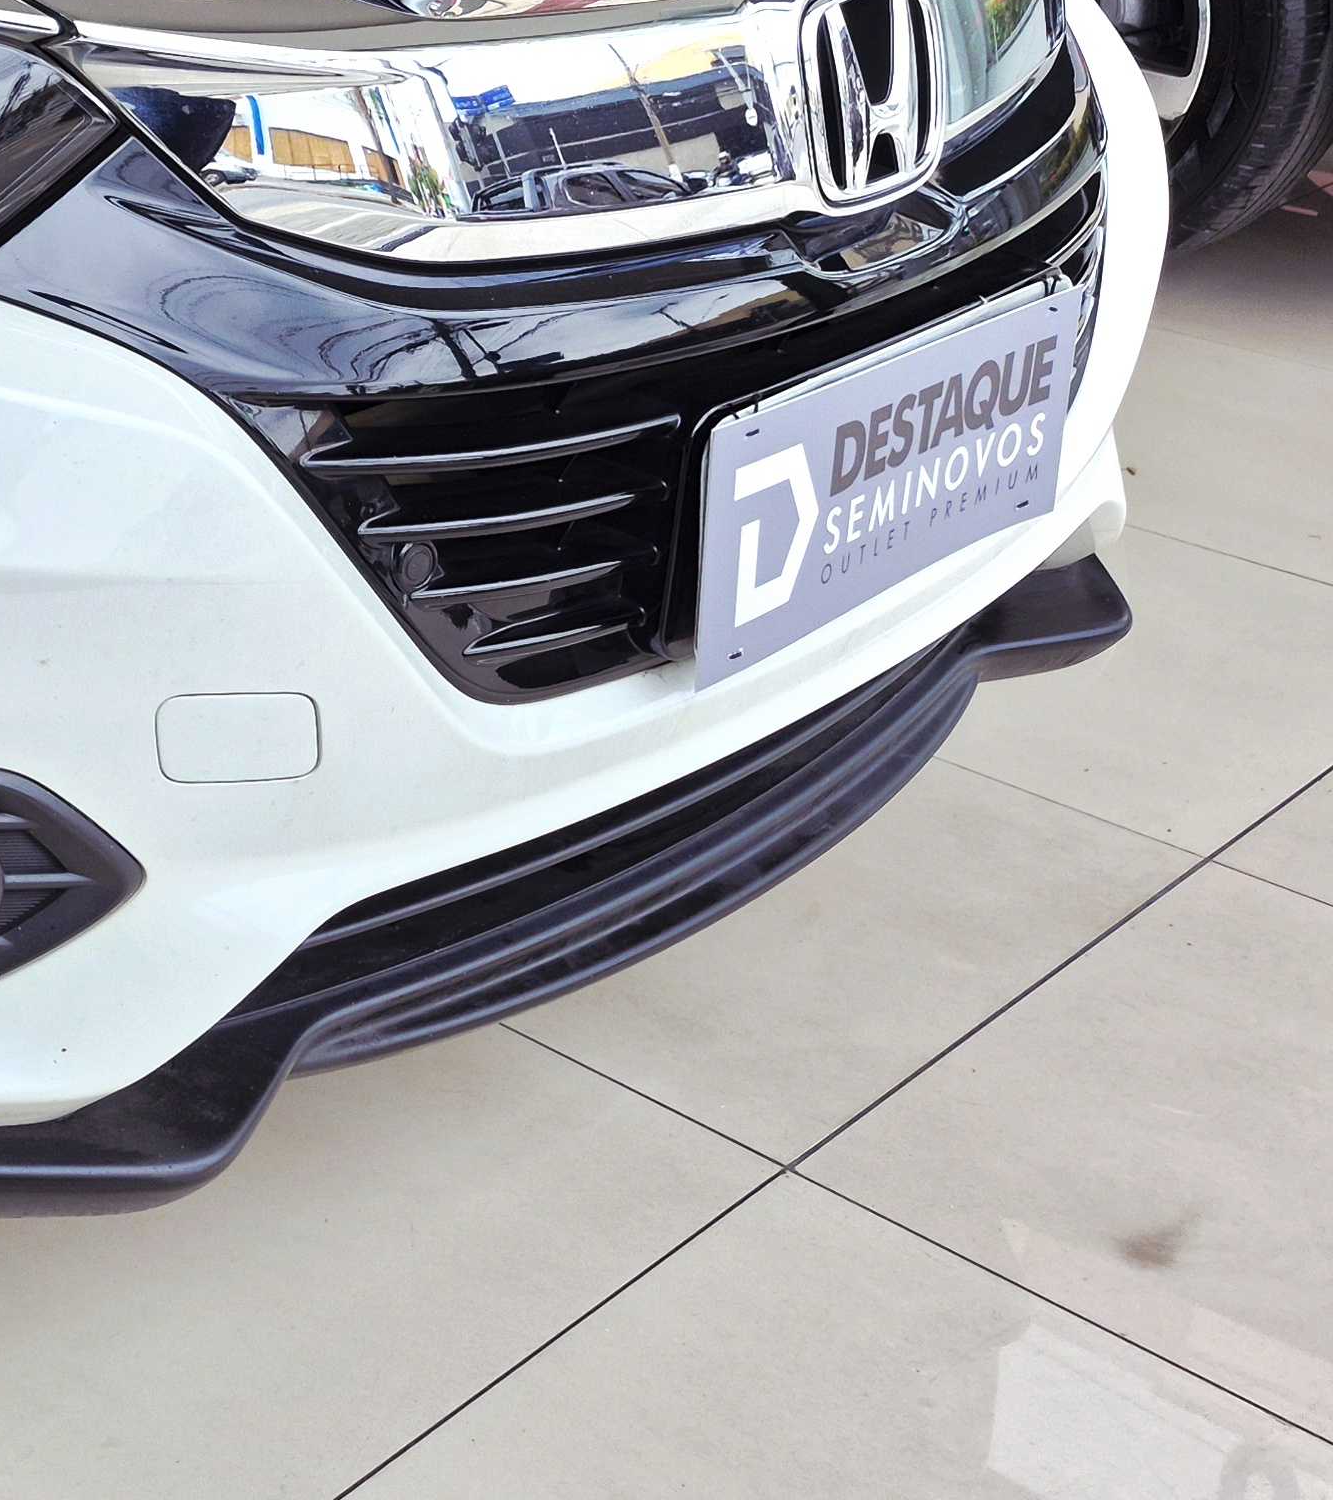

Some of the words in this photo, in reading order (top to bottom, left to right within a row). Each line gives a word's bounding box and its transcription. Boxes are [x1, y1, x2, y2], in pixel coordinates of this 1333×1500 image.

[822, 411, 1046, 555] SEMINOVOS
[830, 334, 1058, 497] DESTAQUE
[820, 520, 911, 585] OUTLET
[929, 464, 1040, 527] PREMIUM
